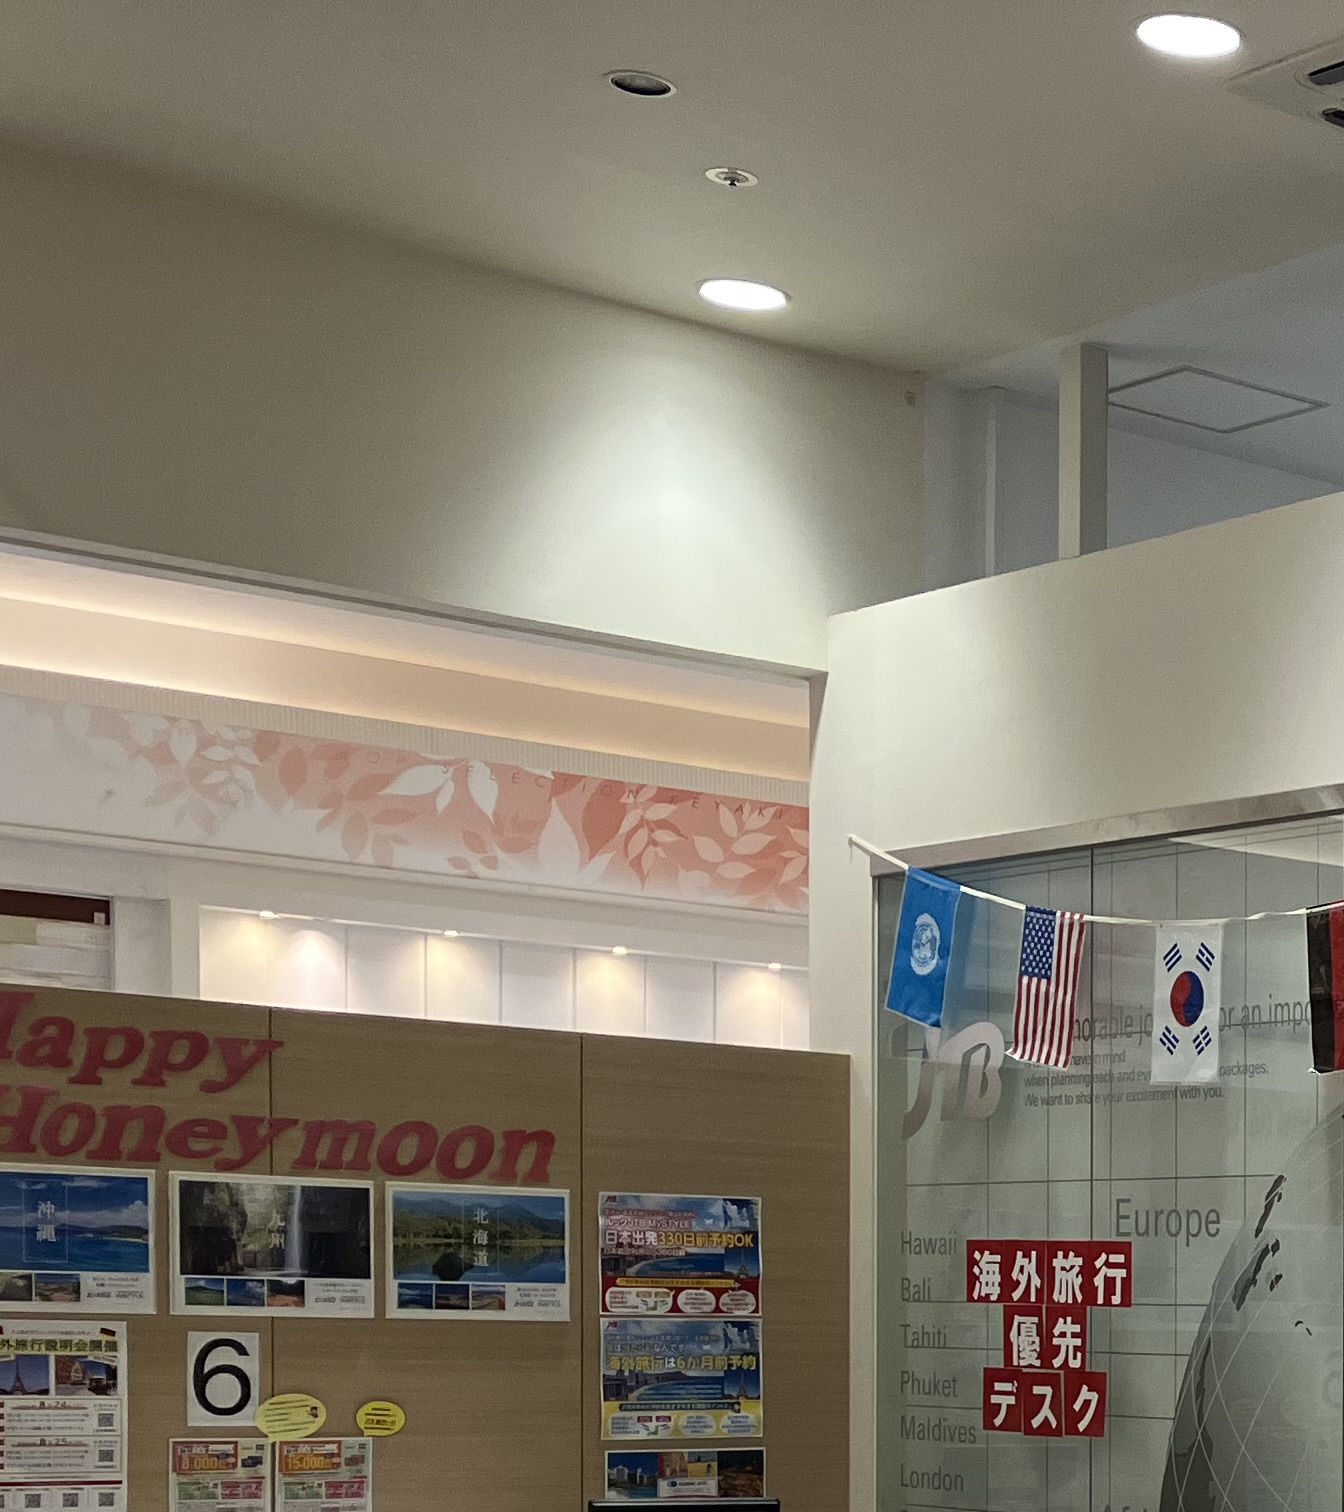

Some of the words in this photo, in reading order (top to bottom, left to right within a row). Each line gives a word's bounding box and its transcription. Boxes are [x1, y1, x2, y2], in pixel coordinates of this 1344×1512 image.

[668, 793, 786, 820] KEYAKI
[1241, 1003, 1261, 1031] an
[1041, 1094, 1063, 1107] want
[1179, 1086, 1202, 1101] with
[1116, 1199, 1221, 1247] Europe
[472, 1207, 489, 1268] 北海道
[605, 1231, 754, 1248] 日本出発330日前予約OK
[901, 1231, 959, 1256] Hawaii
[901, 1277, 932, 1303] Bali
[972, 1250, 1127, 1304] 海外旅行
[901, 1324, 947, 1348] Tahiti
[1010, 1315, 1082, 1368] 優先
[191, 1338, 252, 1416] 6
[901, 1371, 958, 1398] Phuket
[990, 1380, 1099, 1432] デスク
[901, 1415, 977, 1444] Maldives
[901, 1464, 964, 1492] London
